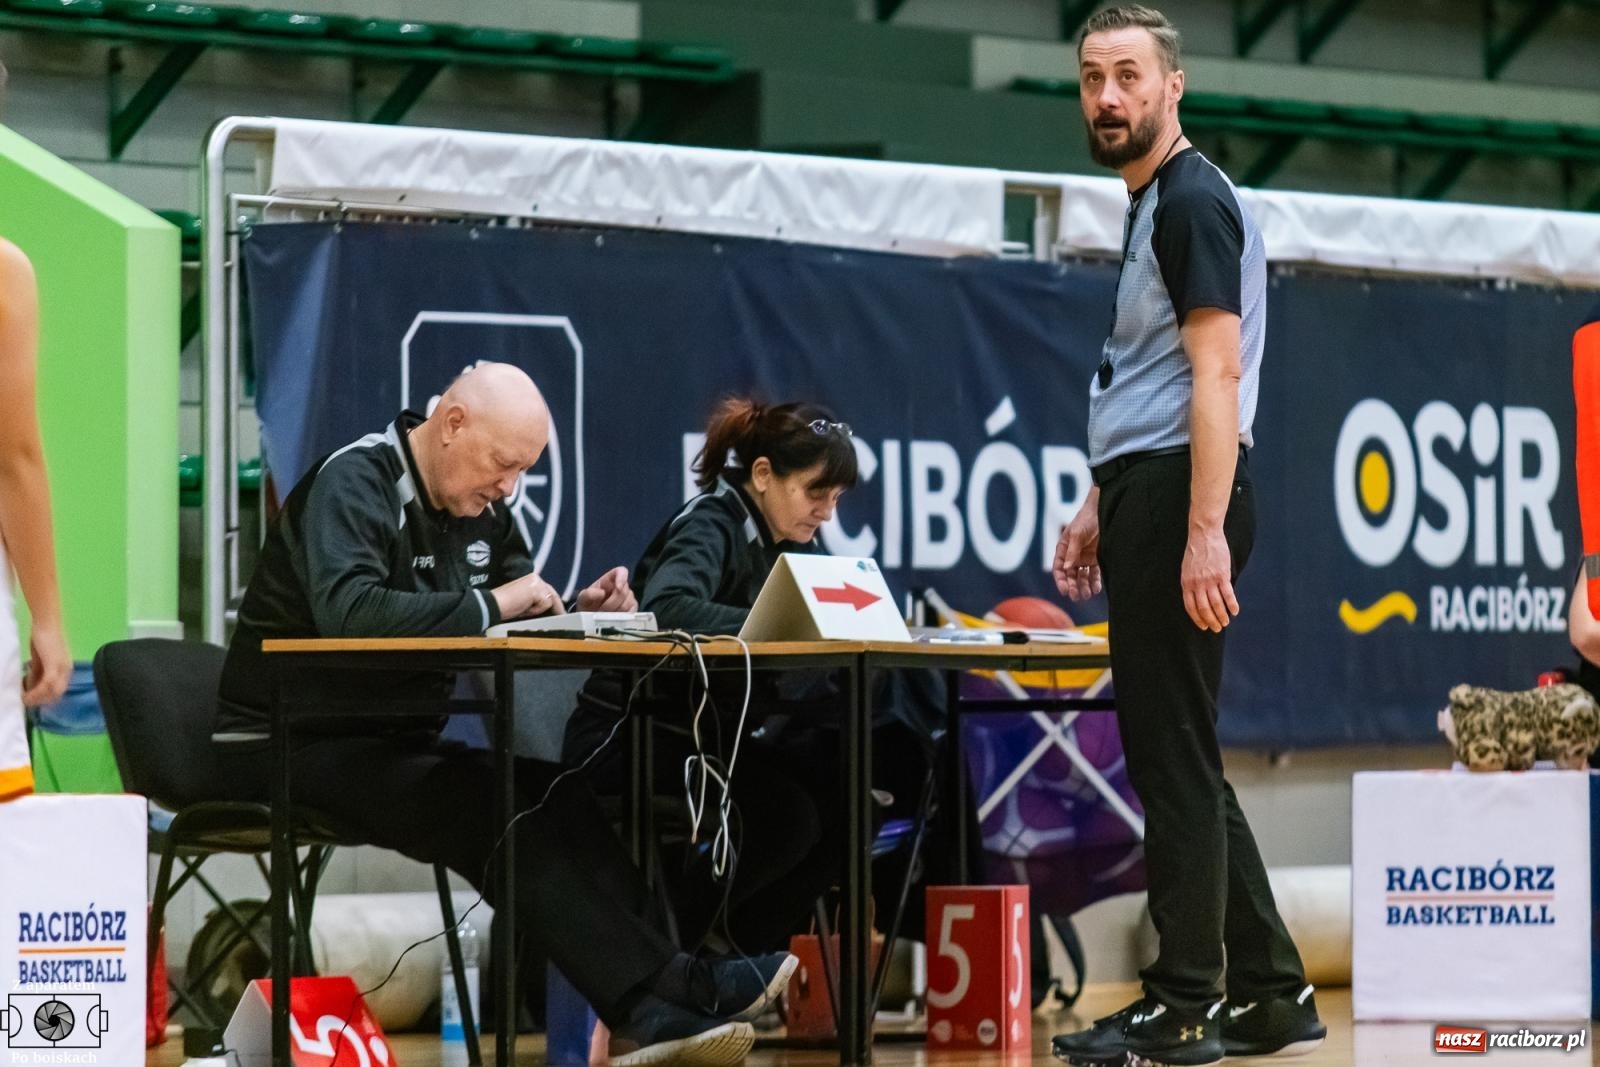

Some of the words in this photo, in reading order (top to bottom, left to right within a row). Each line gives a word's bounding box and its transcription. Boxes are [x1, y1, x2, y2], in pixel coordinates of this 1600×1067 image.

[683, 396, 1097, 573] CIBÓR
[1334, 398, 1565, 569] OSiR
[1430, 572, 1567, 632] RACIBÓRZ
[1386, 859, 1555, 891] RACIBÓRZ
[18, 903, 127, 942] RACIBÓRZ
[1386, 905, 1555, 926] BASKETBALL
[18, 959, 127, 984] BASKETBALL
[926, 904, 975, 1009] 5
[1008, 902, 1024, 1009] 5
